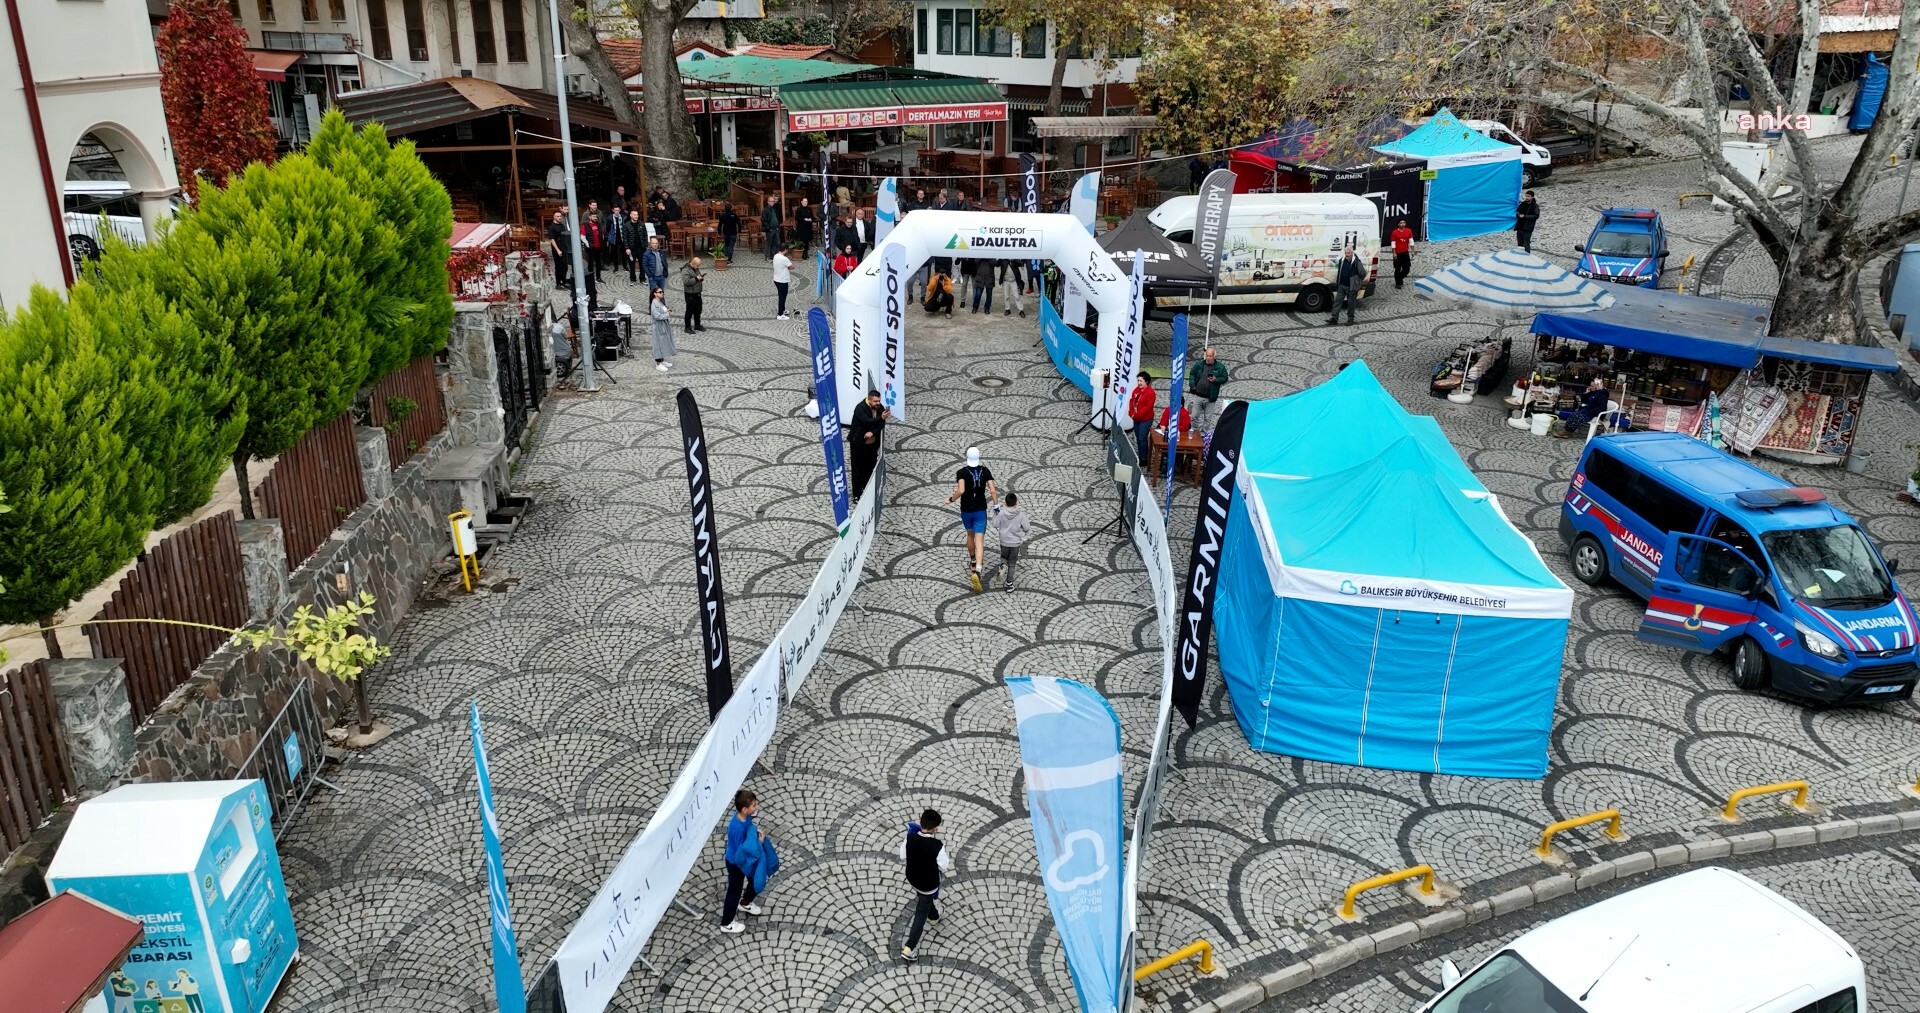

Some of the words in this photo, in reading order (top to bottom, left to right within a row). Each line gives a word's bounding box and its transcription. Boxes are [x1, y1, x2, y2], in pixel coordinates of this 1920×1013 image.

[909, 111, 963, 121] DERTALMAZIN
[1005, 227, 1026, 236] spor
[1265, 220, 1313, 236] ankara
[886, 262, 902, 330] spor
[852, 319, 861, 390] DYNAFIT
[1621, 530, 1663, 565] JANDAR
[1182, 450, 1234, 681] GARMIN
[1360, 586, 1403, 597] BALIKESİR
[1404, 588, 1458, 603] BÜYÜKŞEHİR
[1459, 596, 1506, 609] BELEDİYESİ
[1846, 616, 1905, 631] JANDARMA
[137, 911, 182, 923] REMİT
[143, 923, 186, 934] EDİYESİ
